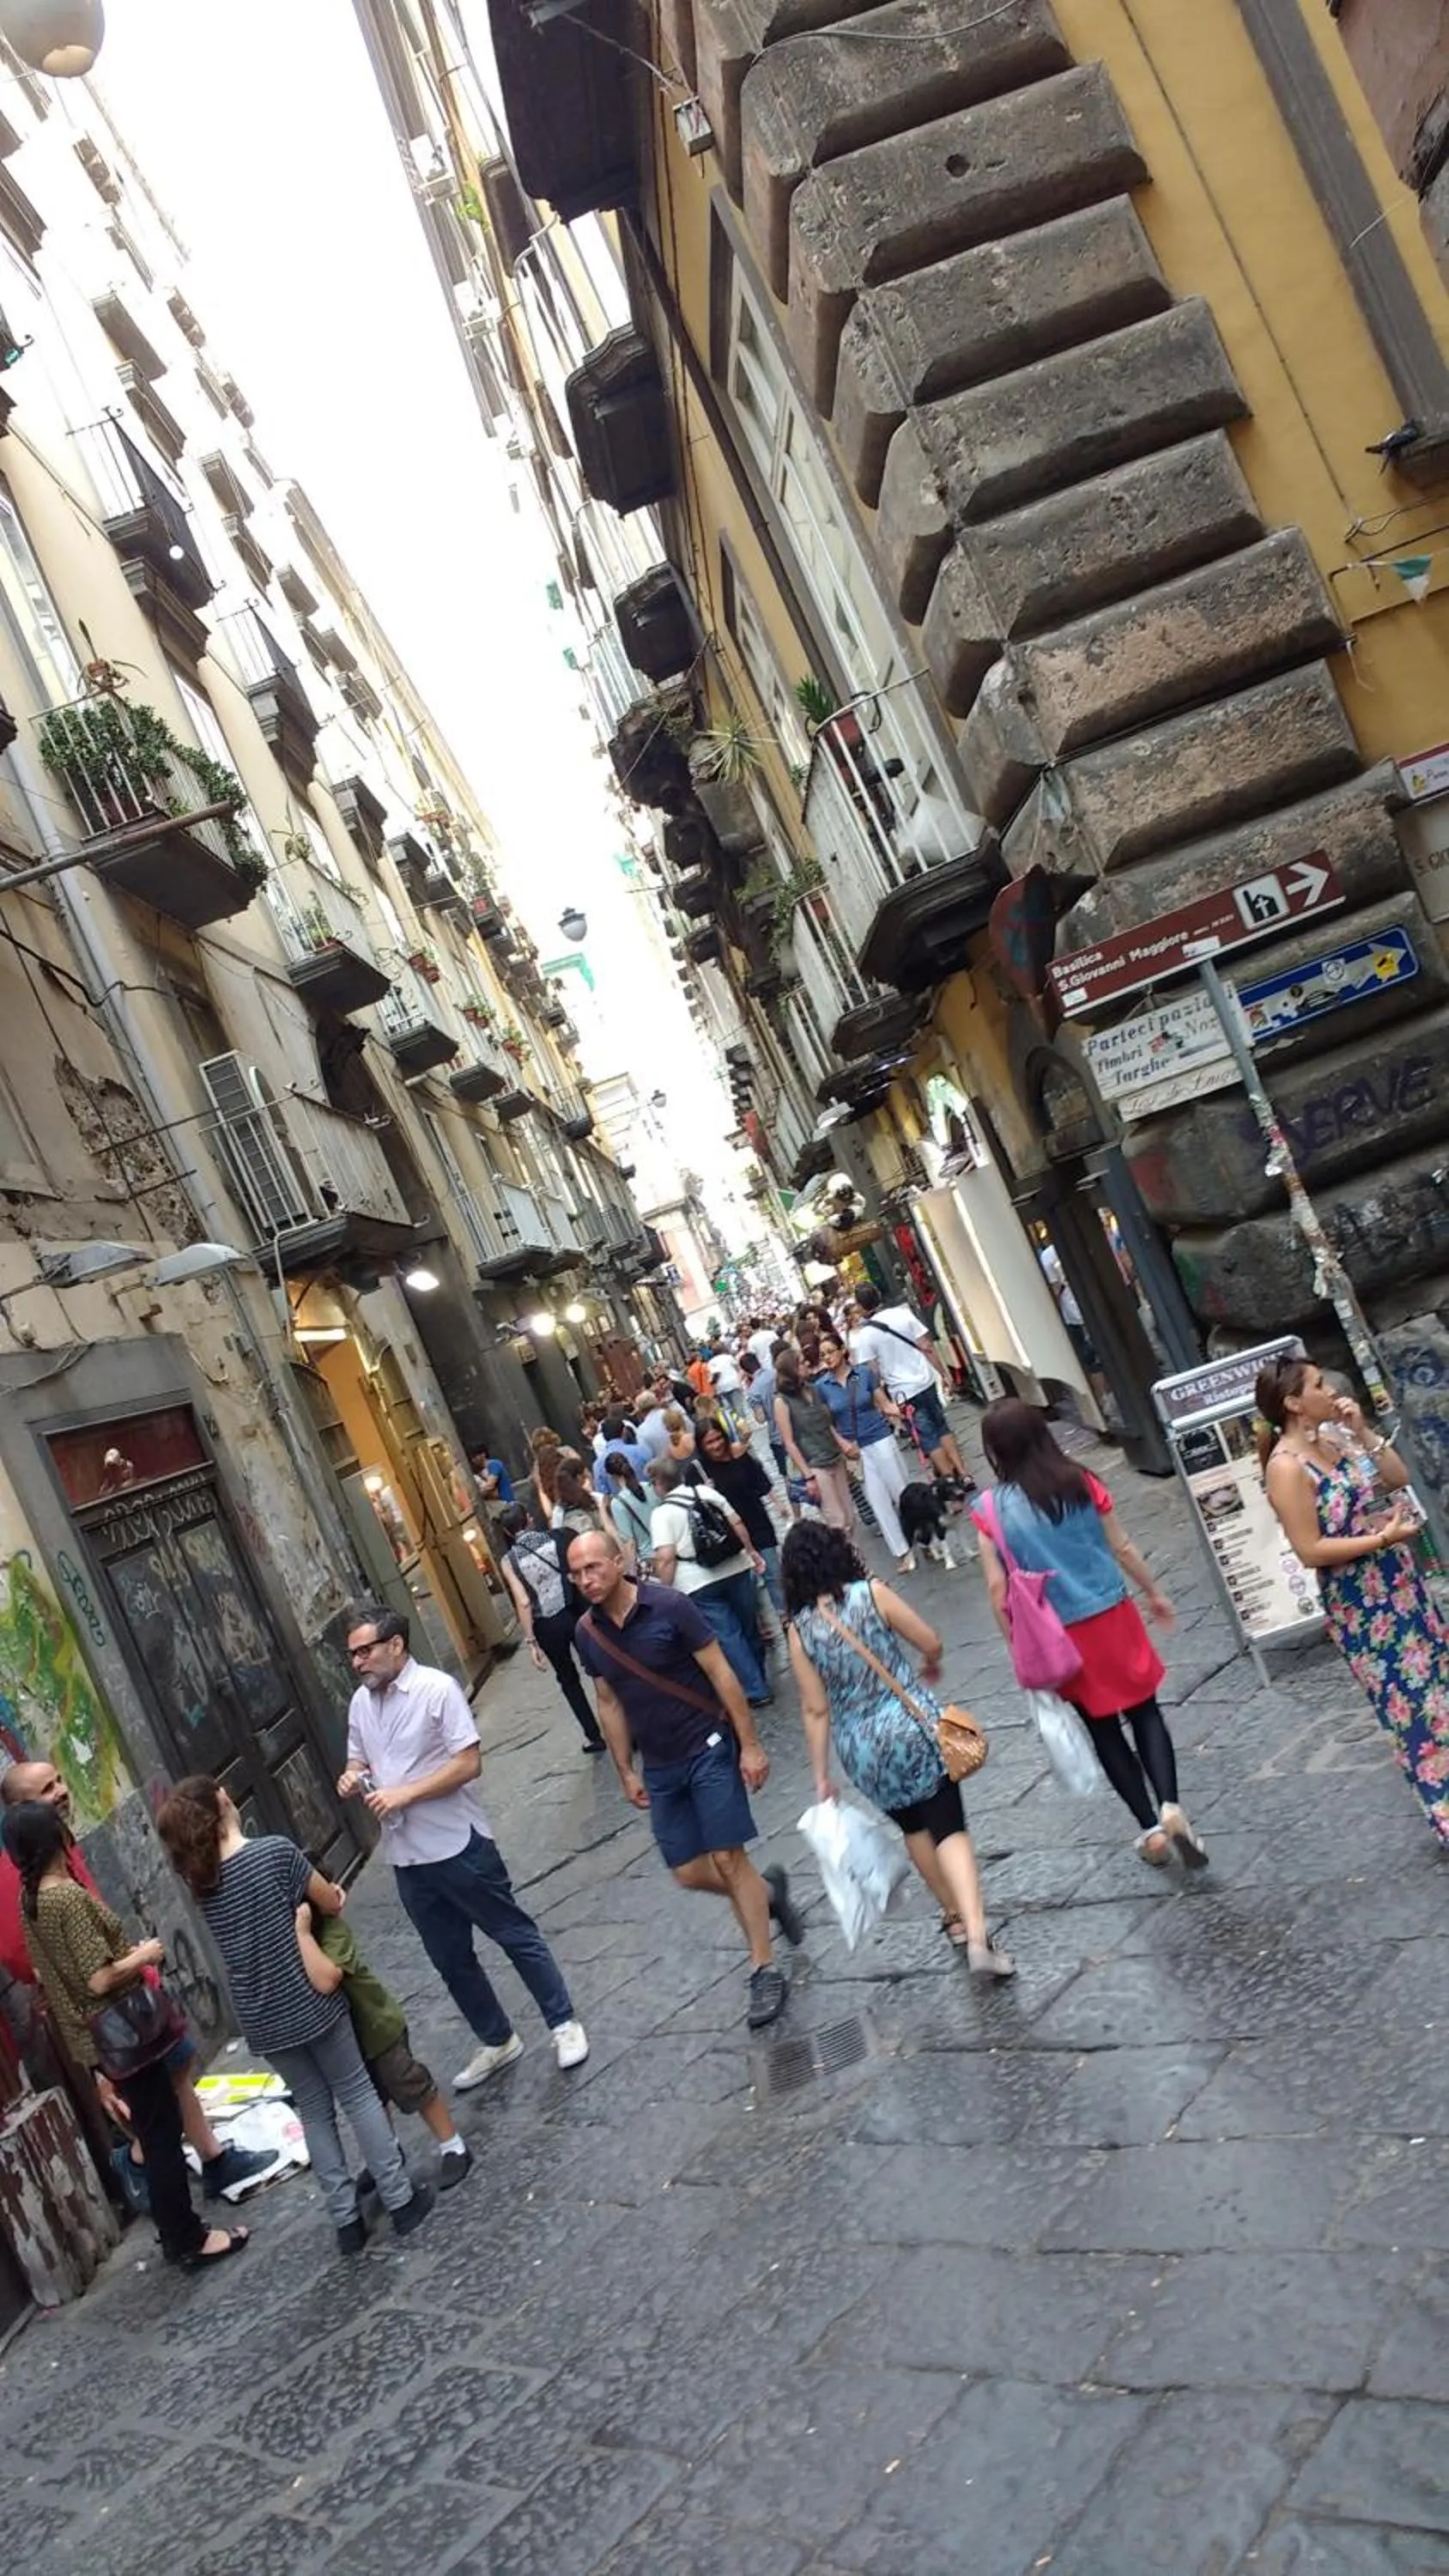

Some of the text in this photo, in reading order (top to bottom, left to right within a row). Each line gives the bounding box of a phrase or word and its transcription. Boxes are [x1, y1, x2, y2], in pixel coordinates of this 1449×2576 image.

[1051, 951, 1103, 978] Basilica
[1058, 956, 1126, 992] S.Giovanni
[1129, 931, 1189, 961] Maggiore
